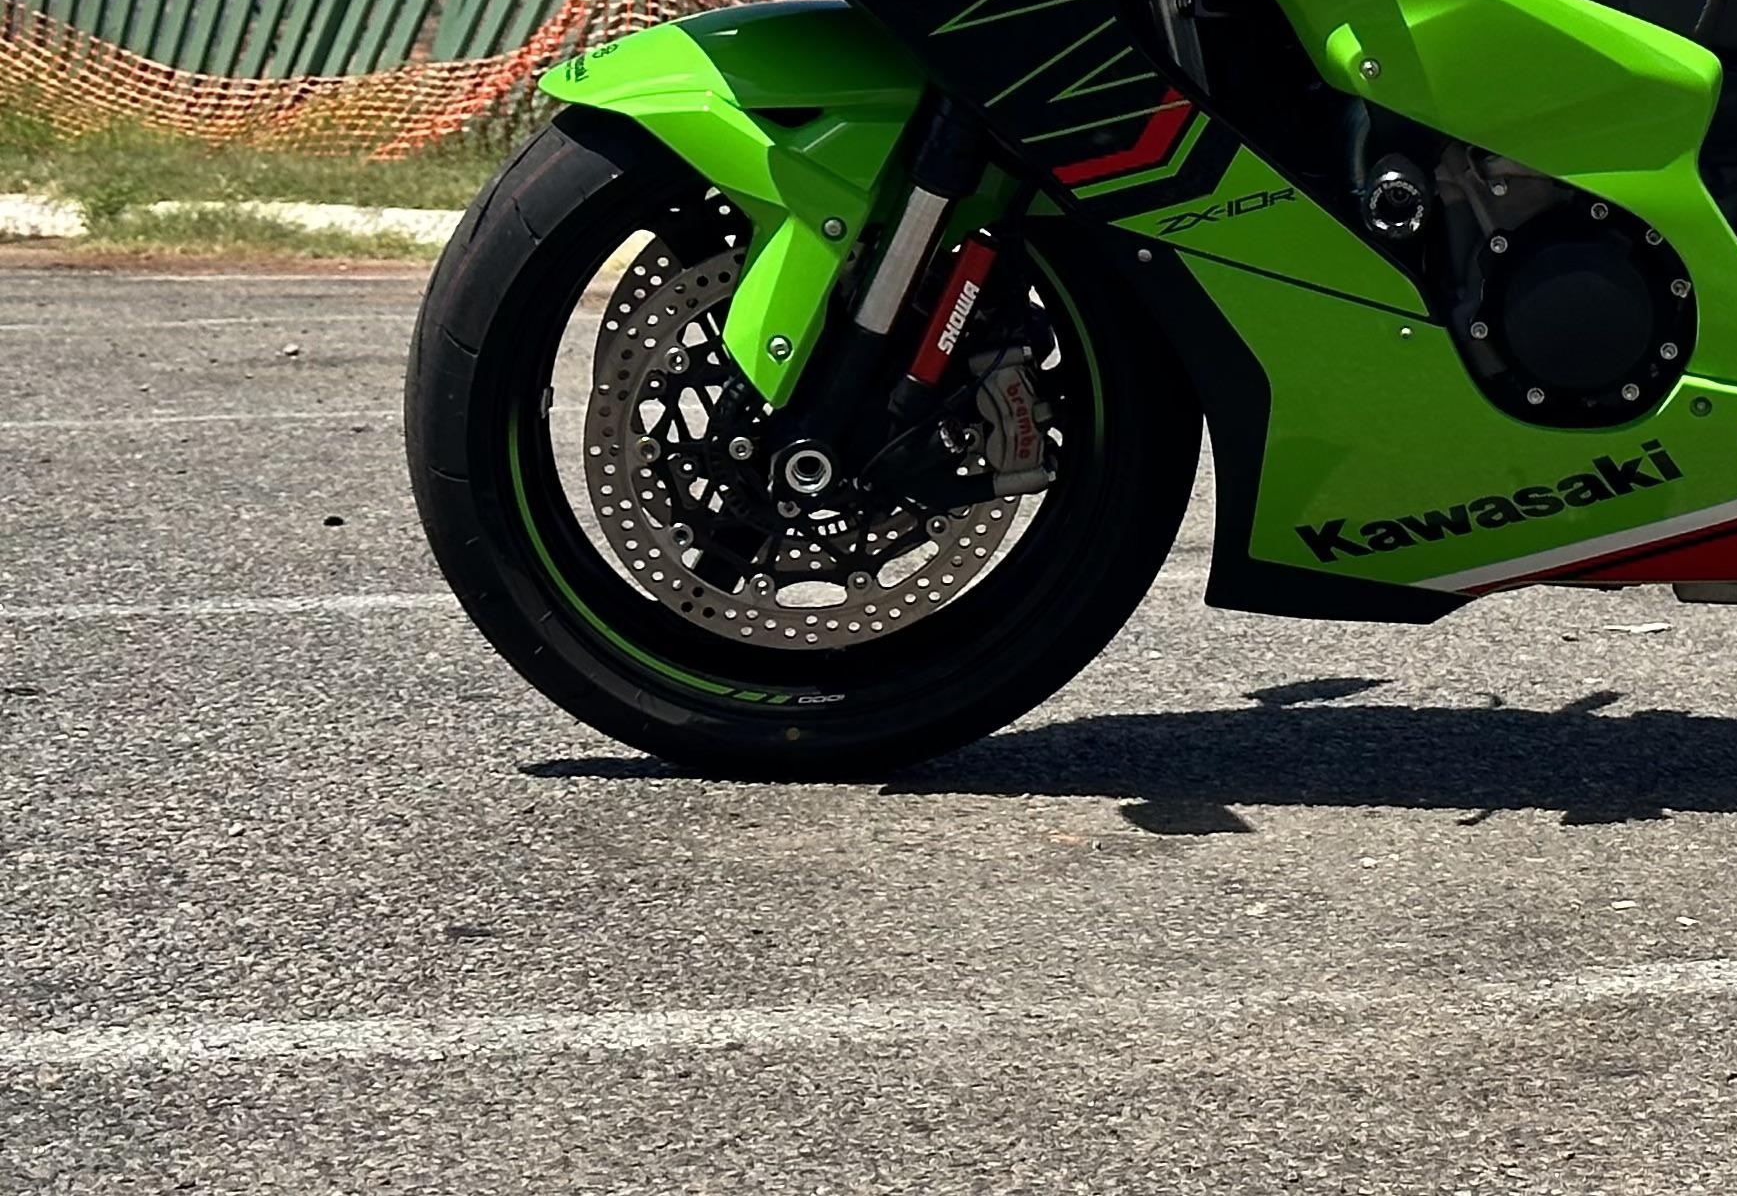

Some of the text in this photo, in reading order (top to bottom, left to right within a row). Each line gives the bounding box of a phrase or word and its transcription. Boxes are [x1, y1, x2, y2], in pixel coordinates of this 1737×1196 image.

[1156, 187, 1296, 236] ZX-10R
[937, 280, 980, 355] SHOWA
[1294, 438, 1684, 563] Kawasaki
